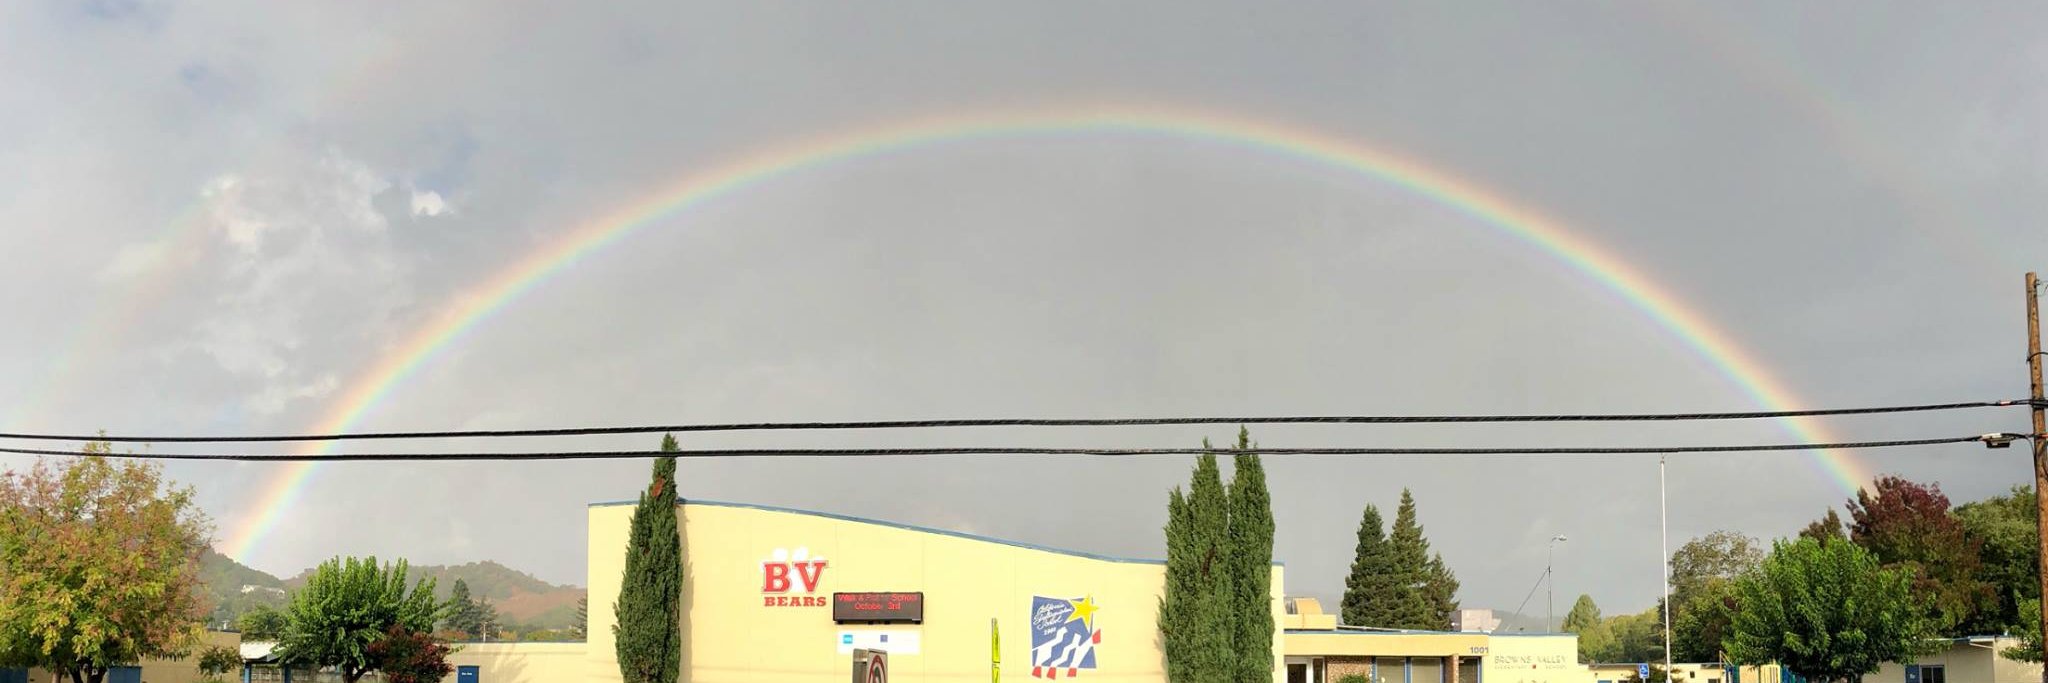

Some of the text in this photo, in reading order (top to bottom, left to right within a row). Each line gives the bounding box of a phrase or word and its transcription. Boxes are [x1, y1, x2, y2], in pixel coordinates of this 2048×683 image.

[762, 562, 827, 592] BV
[763, 596, 827, 607] BEARS
[1470, 646, 1489, 654] 1001
[1537, 655, 1568, 664] VALLEY
